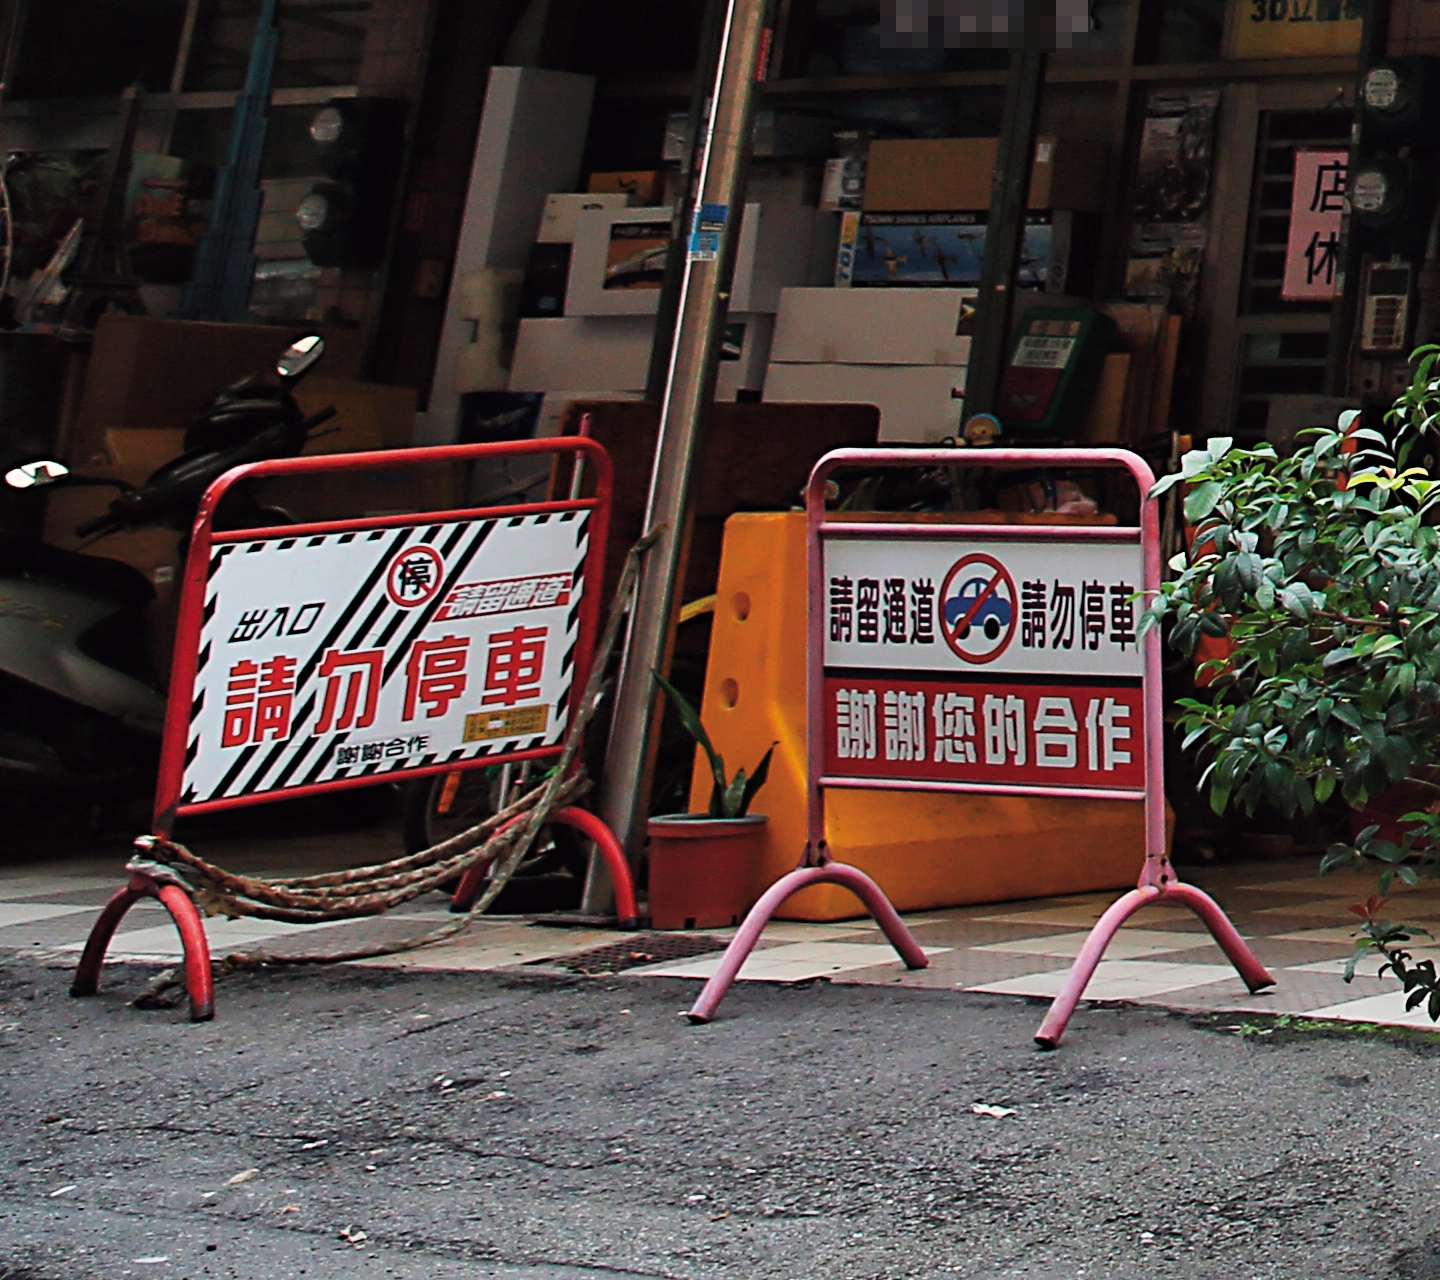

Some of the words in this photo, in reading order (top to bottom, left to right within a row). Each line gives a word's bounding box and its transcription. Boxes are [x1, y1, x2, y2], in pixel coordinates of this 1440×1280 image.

[1304, 160, 1348, 285] 店休
[227, 602, 326, 643] 出入口
[446, 575, 566, 618] 請留通道
[829, 575, 935, 644] 請留通道
[1021, 578, 1137, 652] 請勿停車
[221, 624, 549, 748] 請勿停車
[337, 735, 430, 767] 謝謝合作
[836, 688, 1131, 771] 謝謝您的合作
